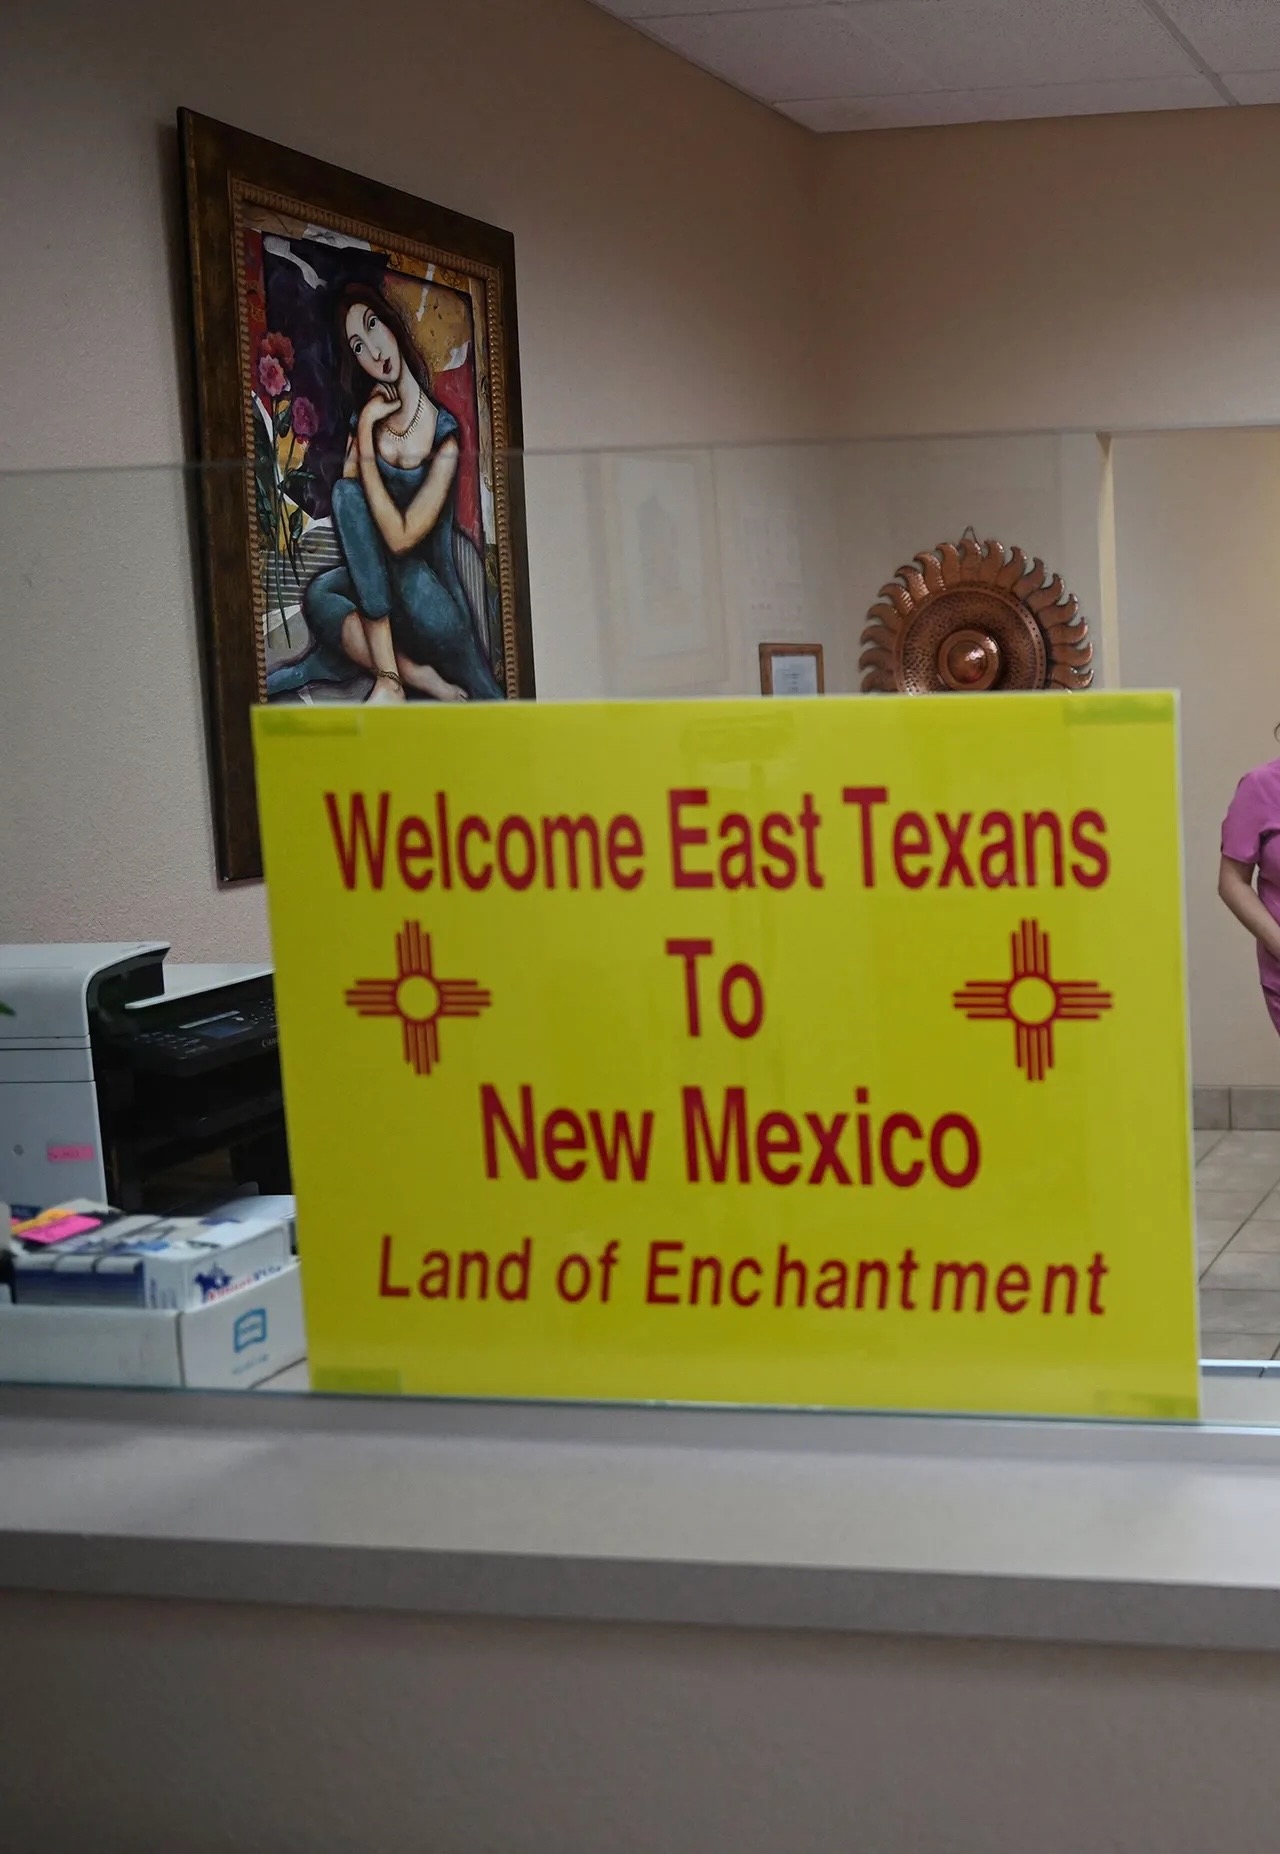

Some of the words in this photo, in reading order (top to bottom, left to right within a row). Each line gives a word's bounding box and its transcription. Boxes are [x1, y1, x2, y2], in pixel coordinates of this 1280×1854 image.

[325, 791, 644, 892] Welcome
[668, 786, 824, 891] East
[842, 785, 1110, 891] Texans
[665, 938, 765, 1040] To
[480, 1083, 654, 1182] New
[682, 1084, 982, 1190] Mexico
[379, 1235, 532, 1301] Land
[556, 1241, 619, 1303] of
[645, 1241, 1108, 1316] Enchantment
